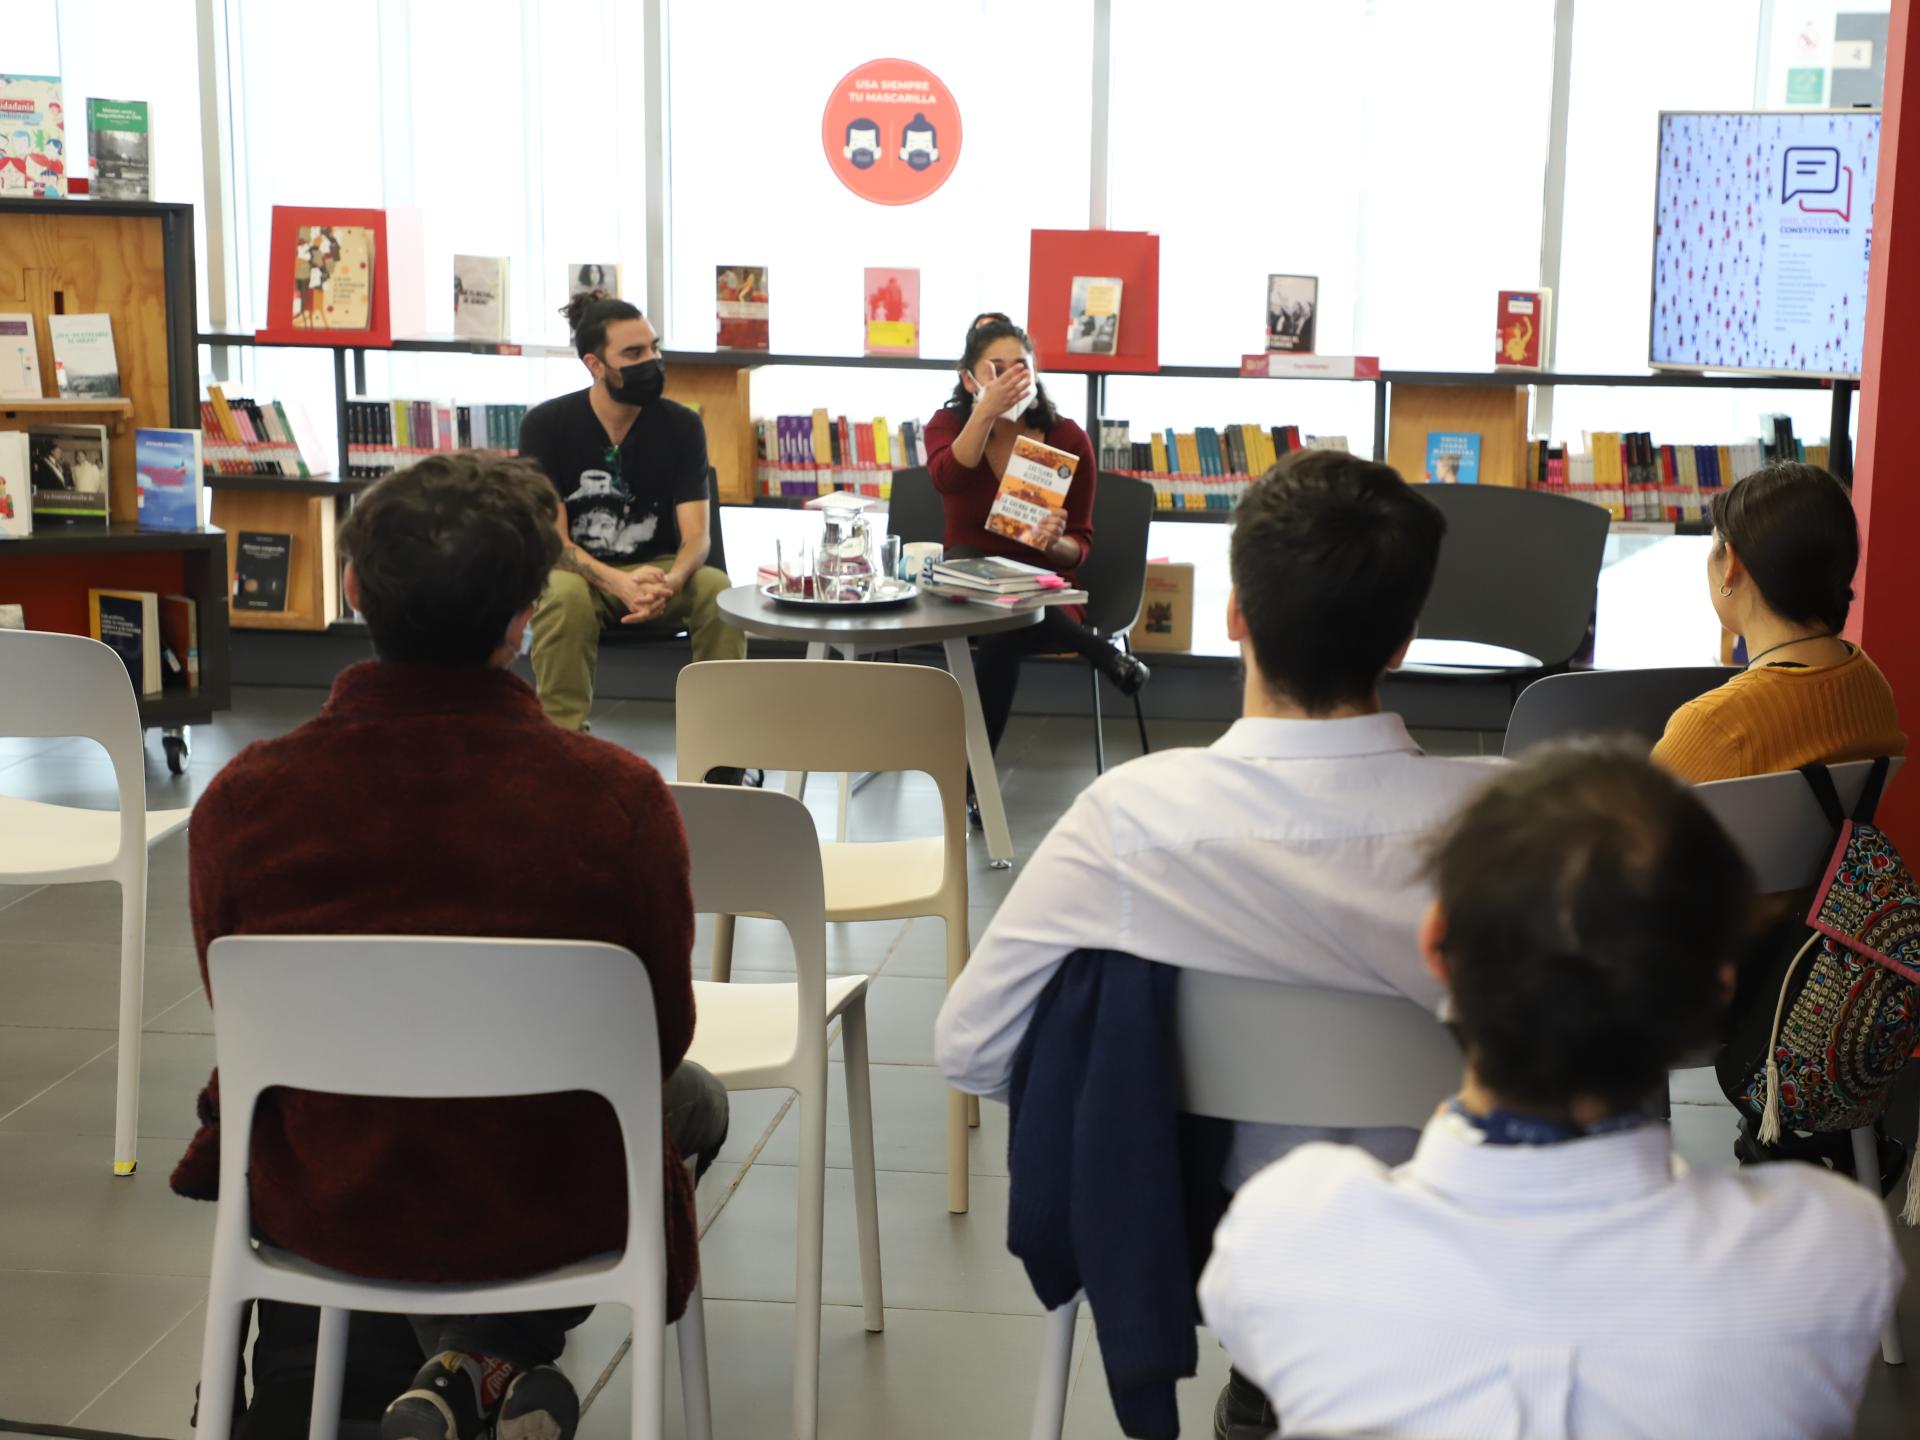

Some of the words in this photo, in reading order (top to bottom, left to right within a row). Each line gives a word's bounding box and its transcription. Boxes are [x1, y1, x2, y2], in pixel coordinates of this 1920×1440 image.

[856, 80, 879, 89] USA
[881, 80, 929, 91] SIEMPRE
[849, 92, 863, 102] TU
[865, 92, 937, 104] MASCARILLA
[1779, 227, 1850, 235] CONSTITUYENTE
